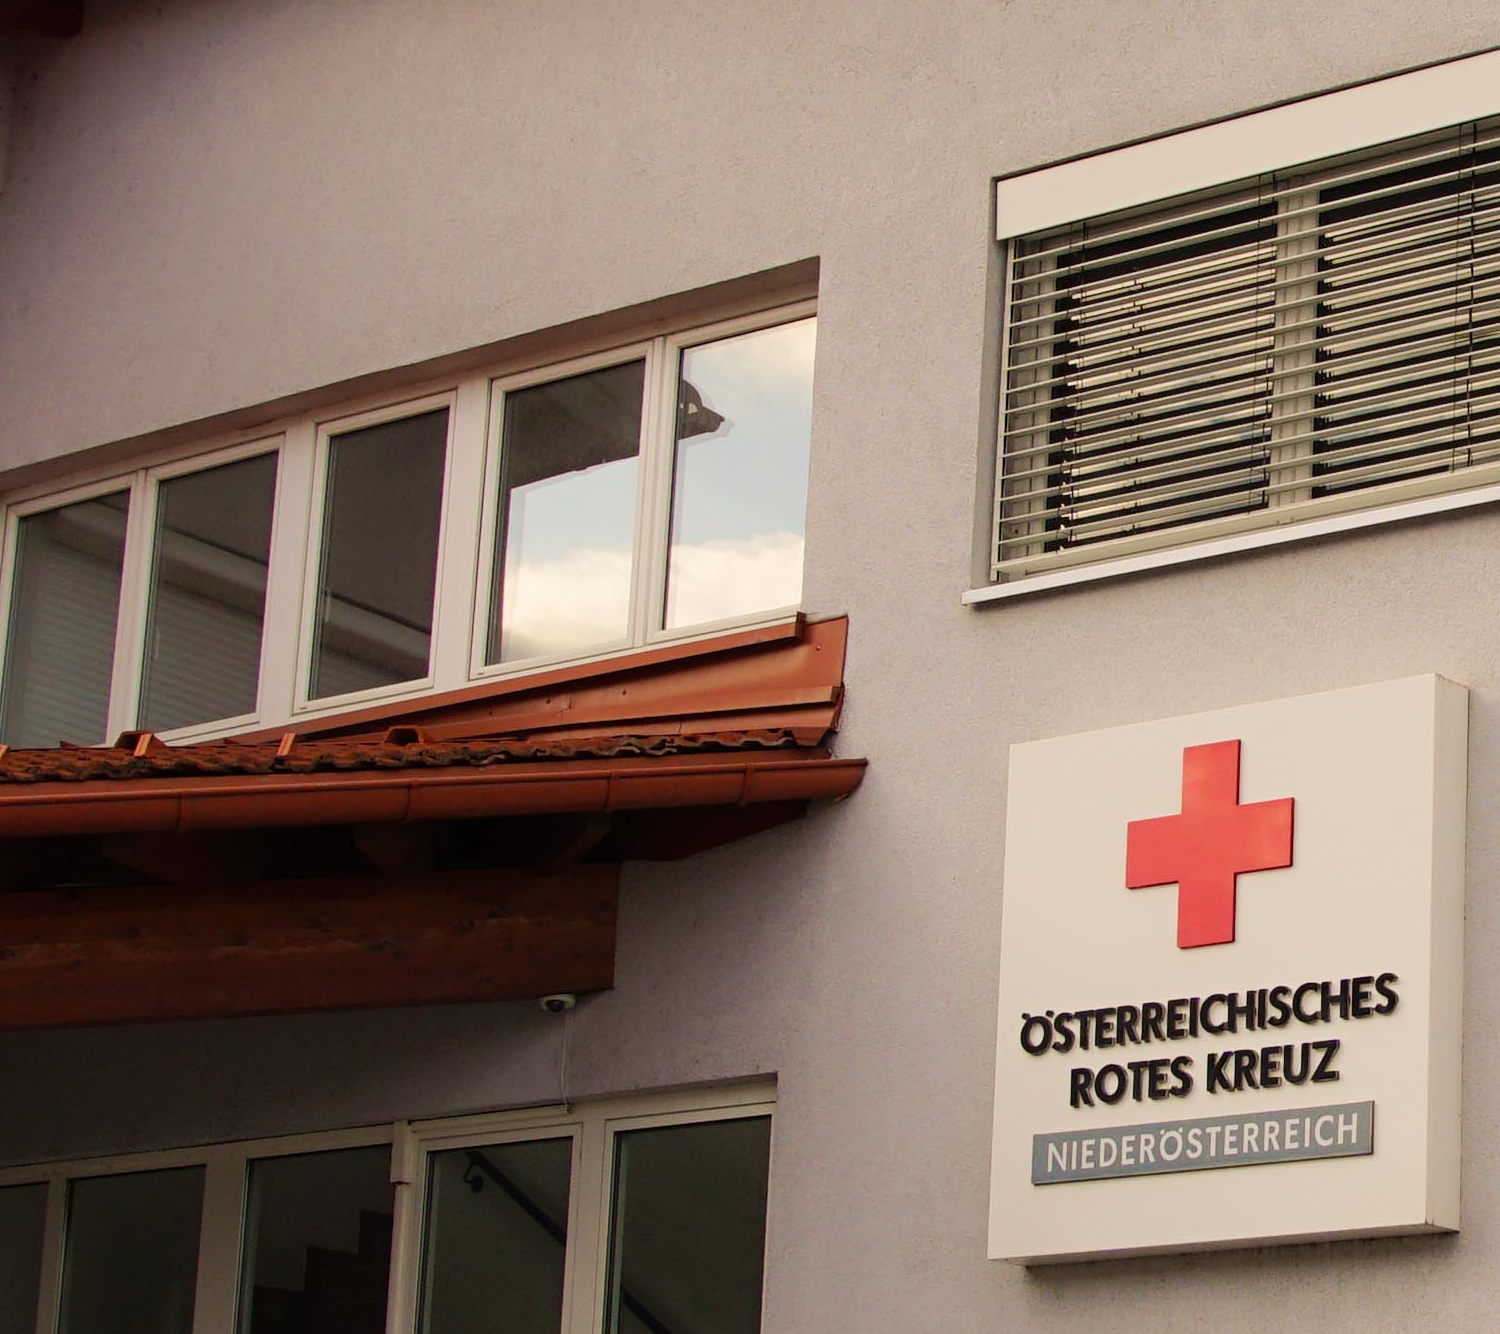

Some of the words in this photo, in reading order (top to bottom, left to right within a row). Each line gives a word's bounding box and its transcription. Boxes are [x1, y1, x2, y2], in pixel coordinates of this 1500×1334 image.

[1019, 971, 1400, 1057] ÖSTERREICHISCHES
[1069, 1056, 1194, 1109] ROTES
[1206, 1039, 1341, 1095] KREUZ
[1046, 1112, 1359, 1174] NIEDERÖSTERREICH
